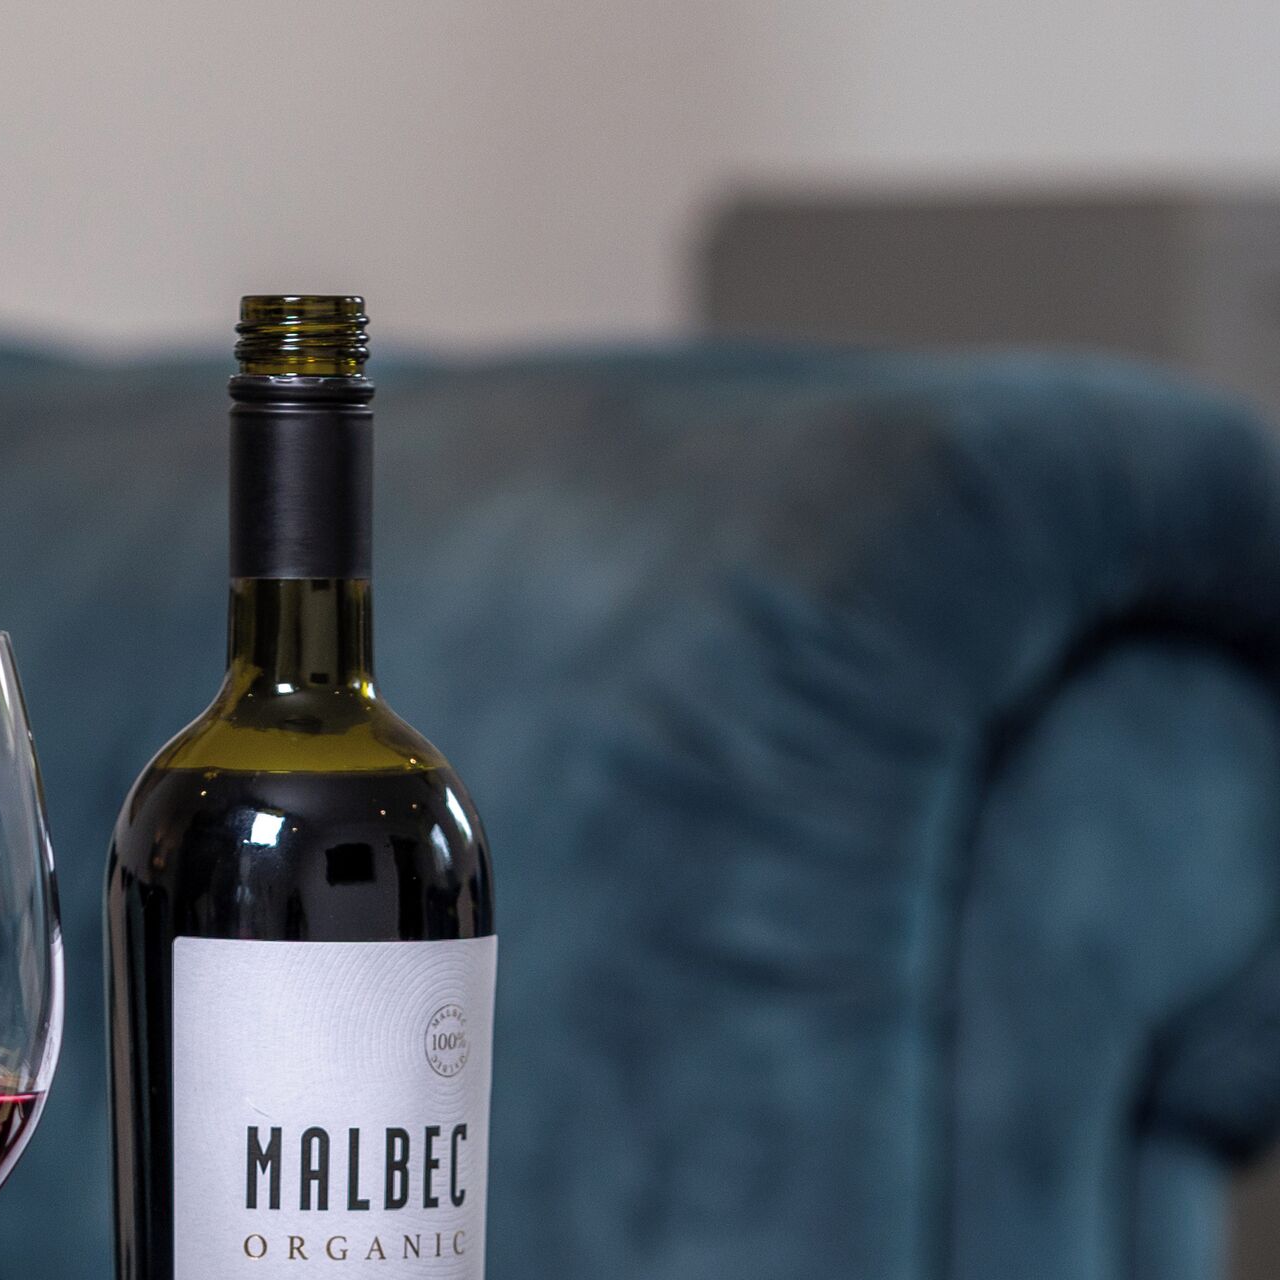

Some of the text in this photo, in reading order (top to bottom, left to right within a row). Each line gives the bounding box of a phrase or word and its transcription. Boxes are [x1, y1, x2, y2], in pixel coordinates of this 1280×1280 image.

[432, 1032, 466, 1051] 100%
[246, 1123, 468, 1211] MALBEC
[243, 1230, 466, 1261] ORGANIC
